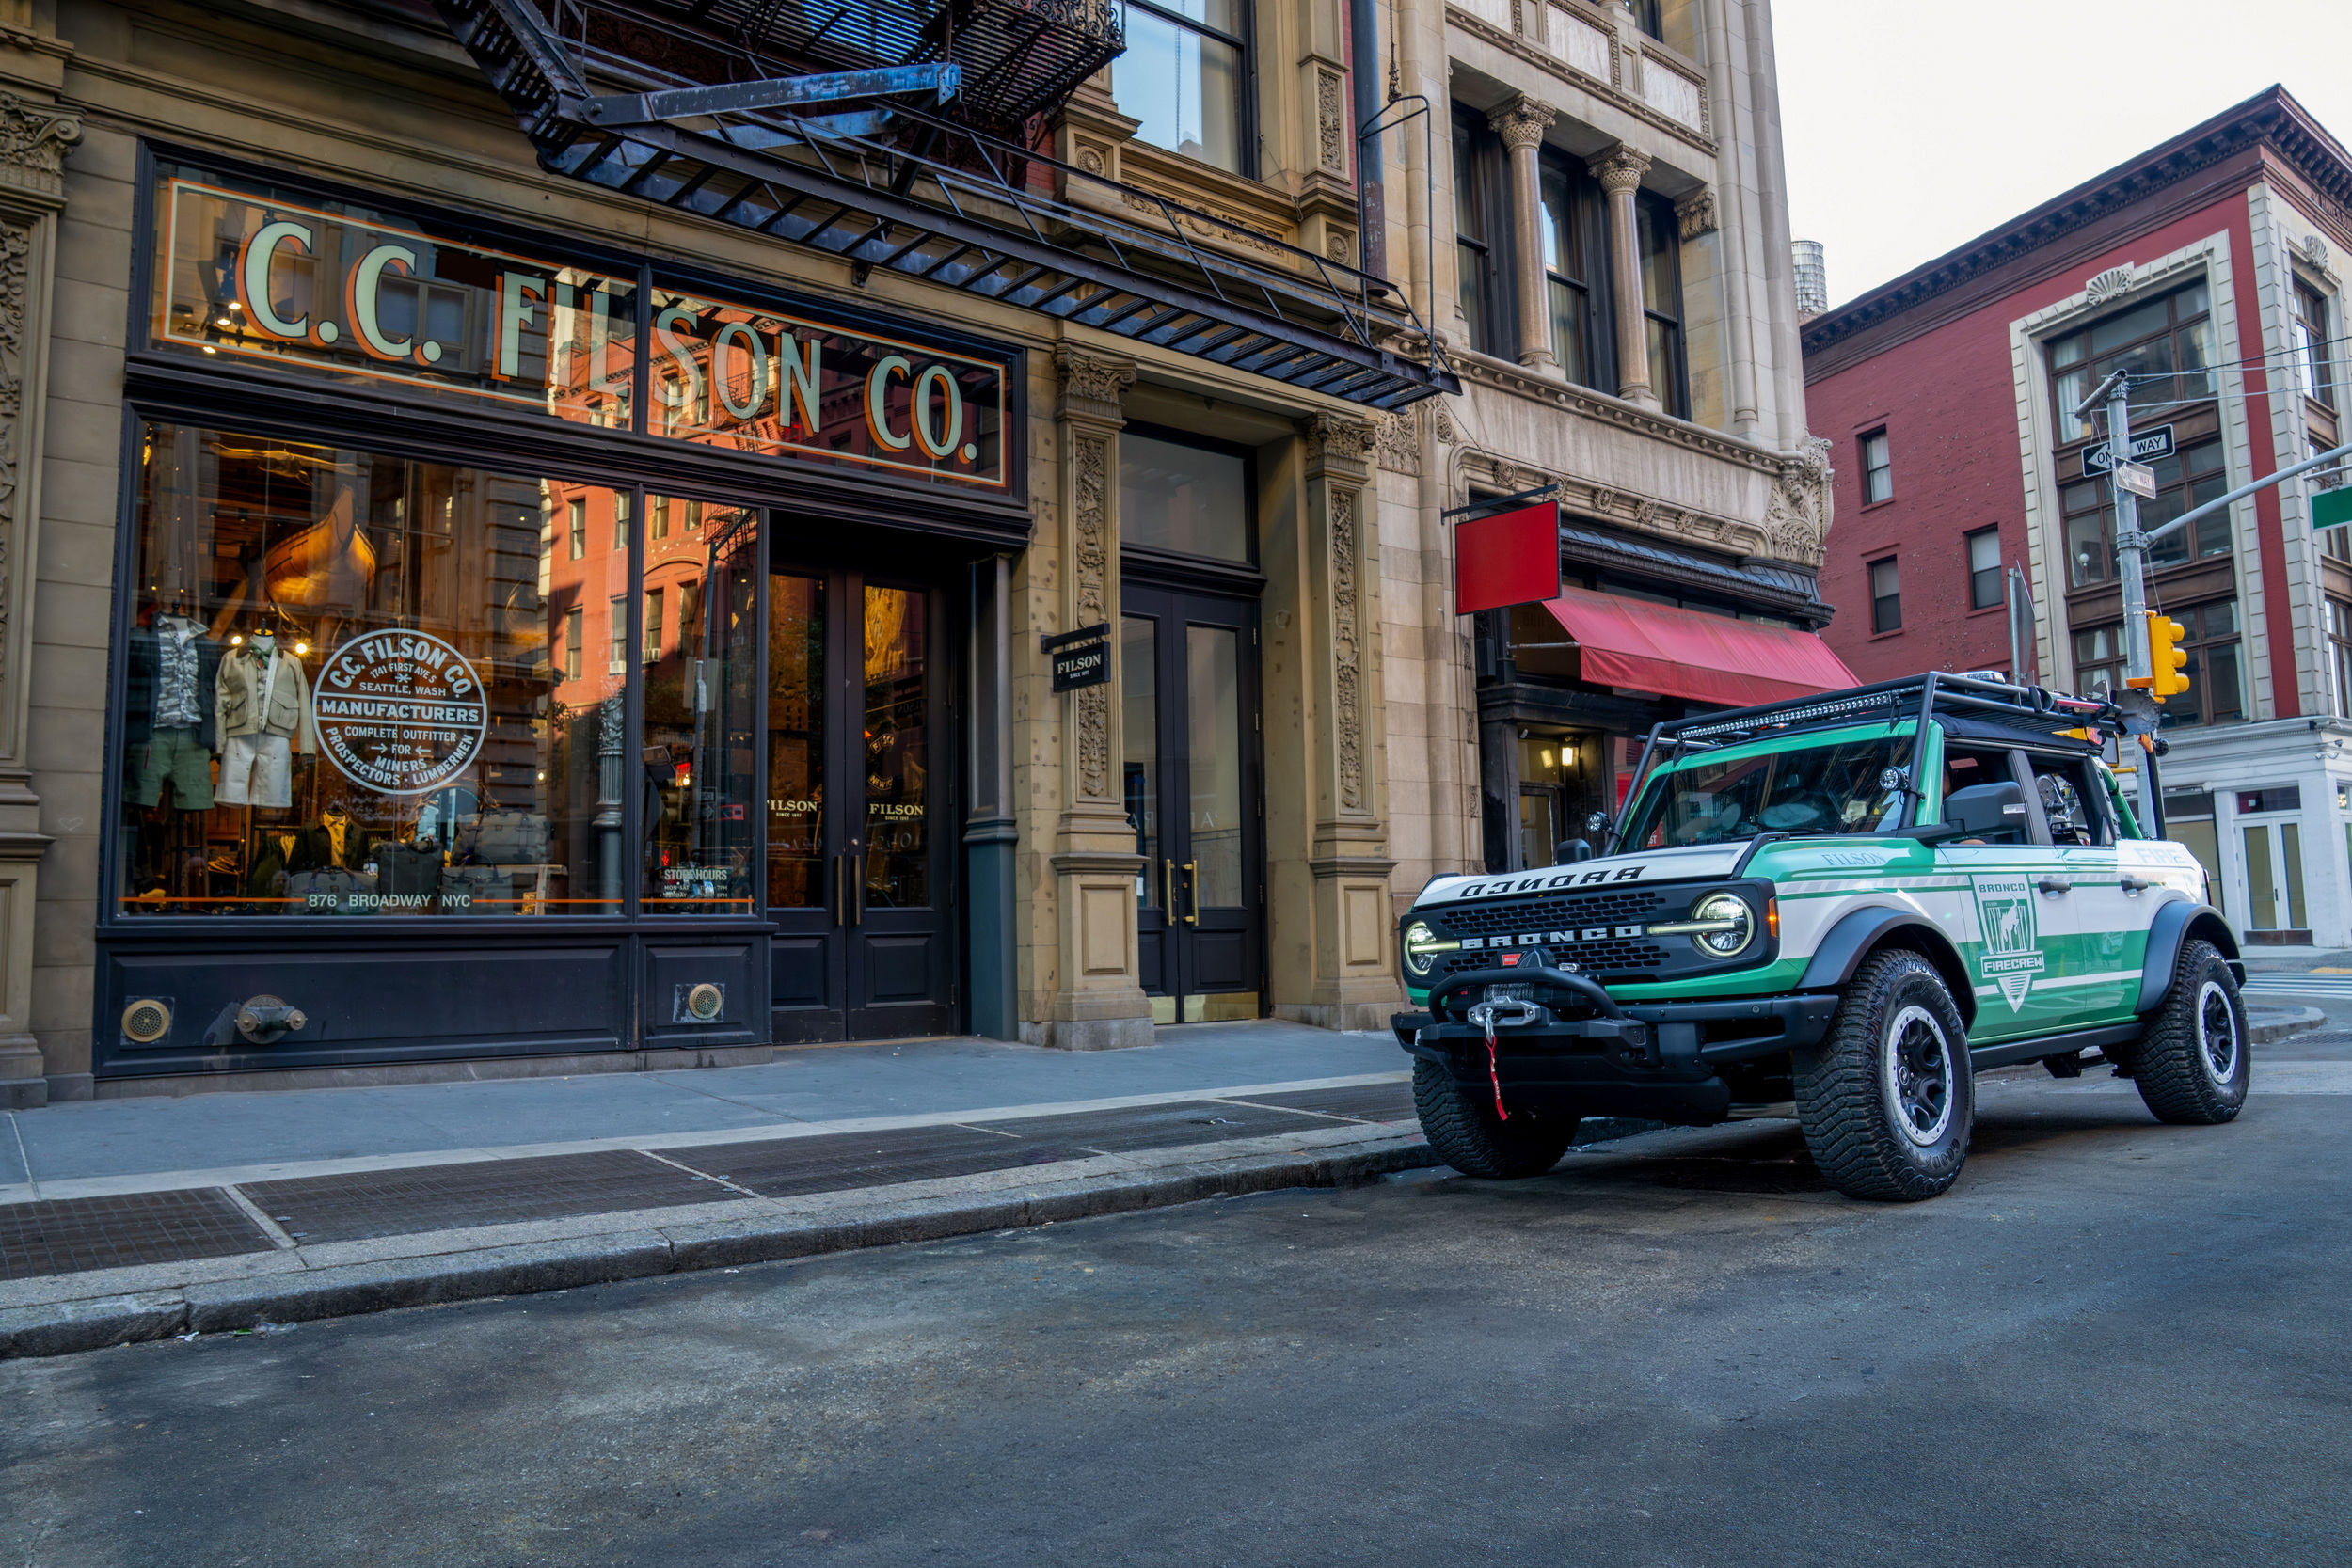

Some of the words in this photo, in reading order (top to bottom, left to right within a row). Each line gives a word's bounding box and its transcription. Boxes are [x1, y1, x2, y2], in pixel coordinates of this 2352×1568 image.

[237, 221, 443, 366] C.C.
[492, 271, 822, 437] FILSON
[865, 355, 977, 465] CO.
[2097, 451, 2112, 464] ON
[2137, 436, 2163, 453] WAY
[2122, 467, 2134, 482] ONE
[2139, 473, 2151, 484] WAY
[329, 656, 366, 689] C.C.
[360, 637, 448, 671] FILSON
[444, 664, 472, 698] CO.
[1057, 654, 1102, 674] FILSON
[370, 665, 388, 679] 1741
[389, 662, 414, 673] FIRST
[413, 665, 430, 679] AVE
[429, 674, 437, 684] S
[359, 682, 412, 695] SEATTLE,
[415, 686, 447, 697] WASH
[321, 699, 480, 723] MANUFACTURERS
[344, 725, 399, 739] COMPLETE
[403, 729, 457, 742] OUTFITTER
[326, 726, 401, 786] PROSPECTORS
[412, 734, 475, 785] LUMBERMEN
[391, 743, 412, 755] FOR
[373, 755, 428, 773] MINERS
[768, 800, 818, 812] ILSON
[869, 803, 924, 816] FILSON
[1820, 852, 1887, 866] FILSON
[2133, 847, 2186, 864] FIRE
[664, 868, 694, 881] STORE
[695, 868, 727, 881] HOURS
[1979, 883, 2026, 893] BRONCO
[308, 894, 338, 908] 876
[348, 894, 432, 908] BROADWAY
[442, 894, 471, 908] NYC
[1461, 925, 1642, 950] BRONCO
[1983, 957, 2042, 973] FIRECREW
